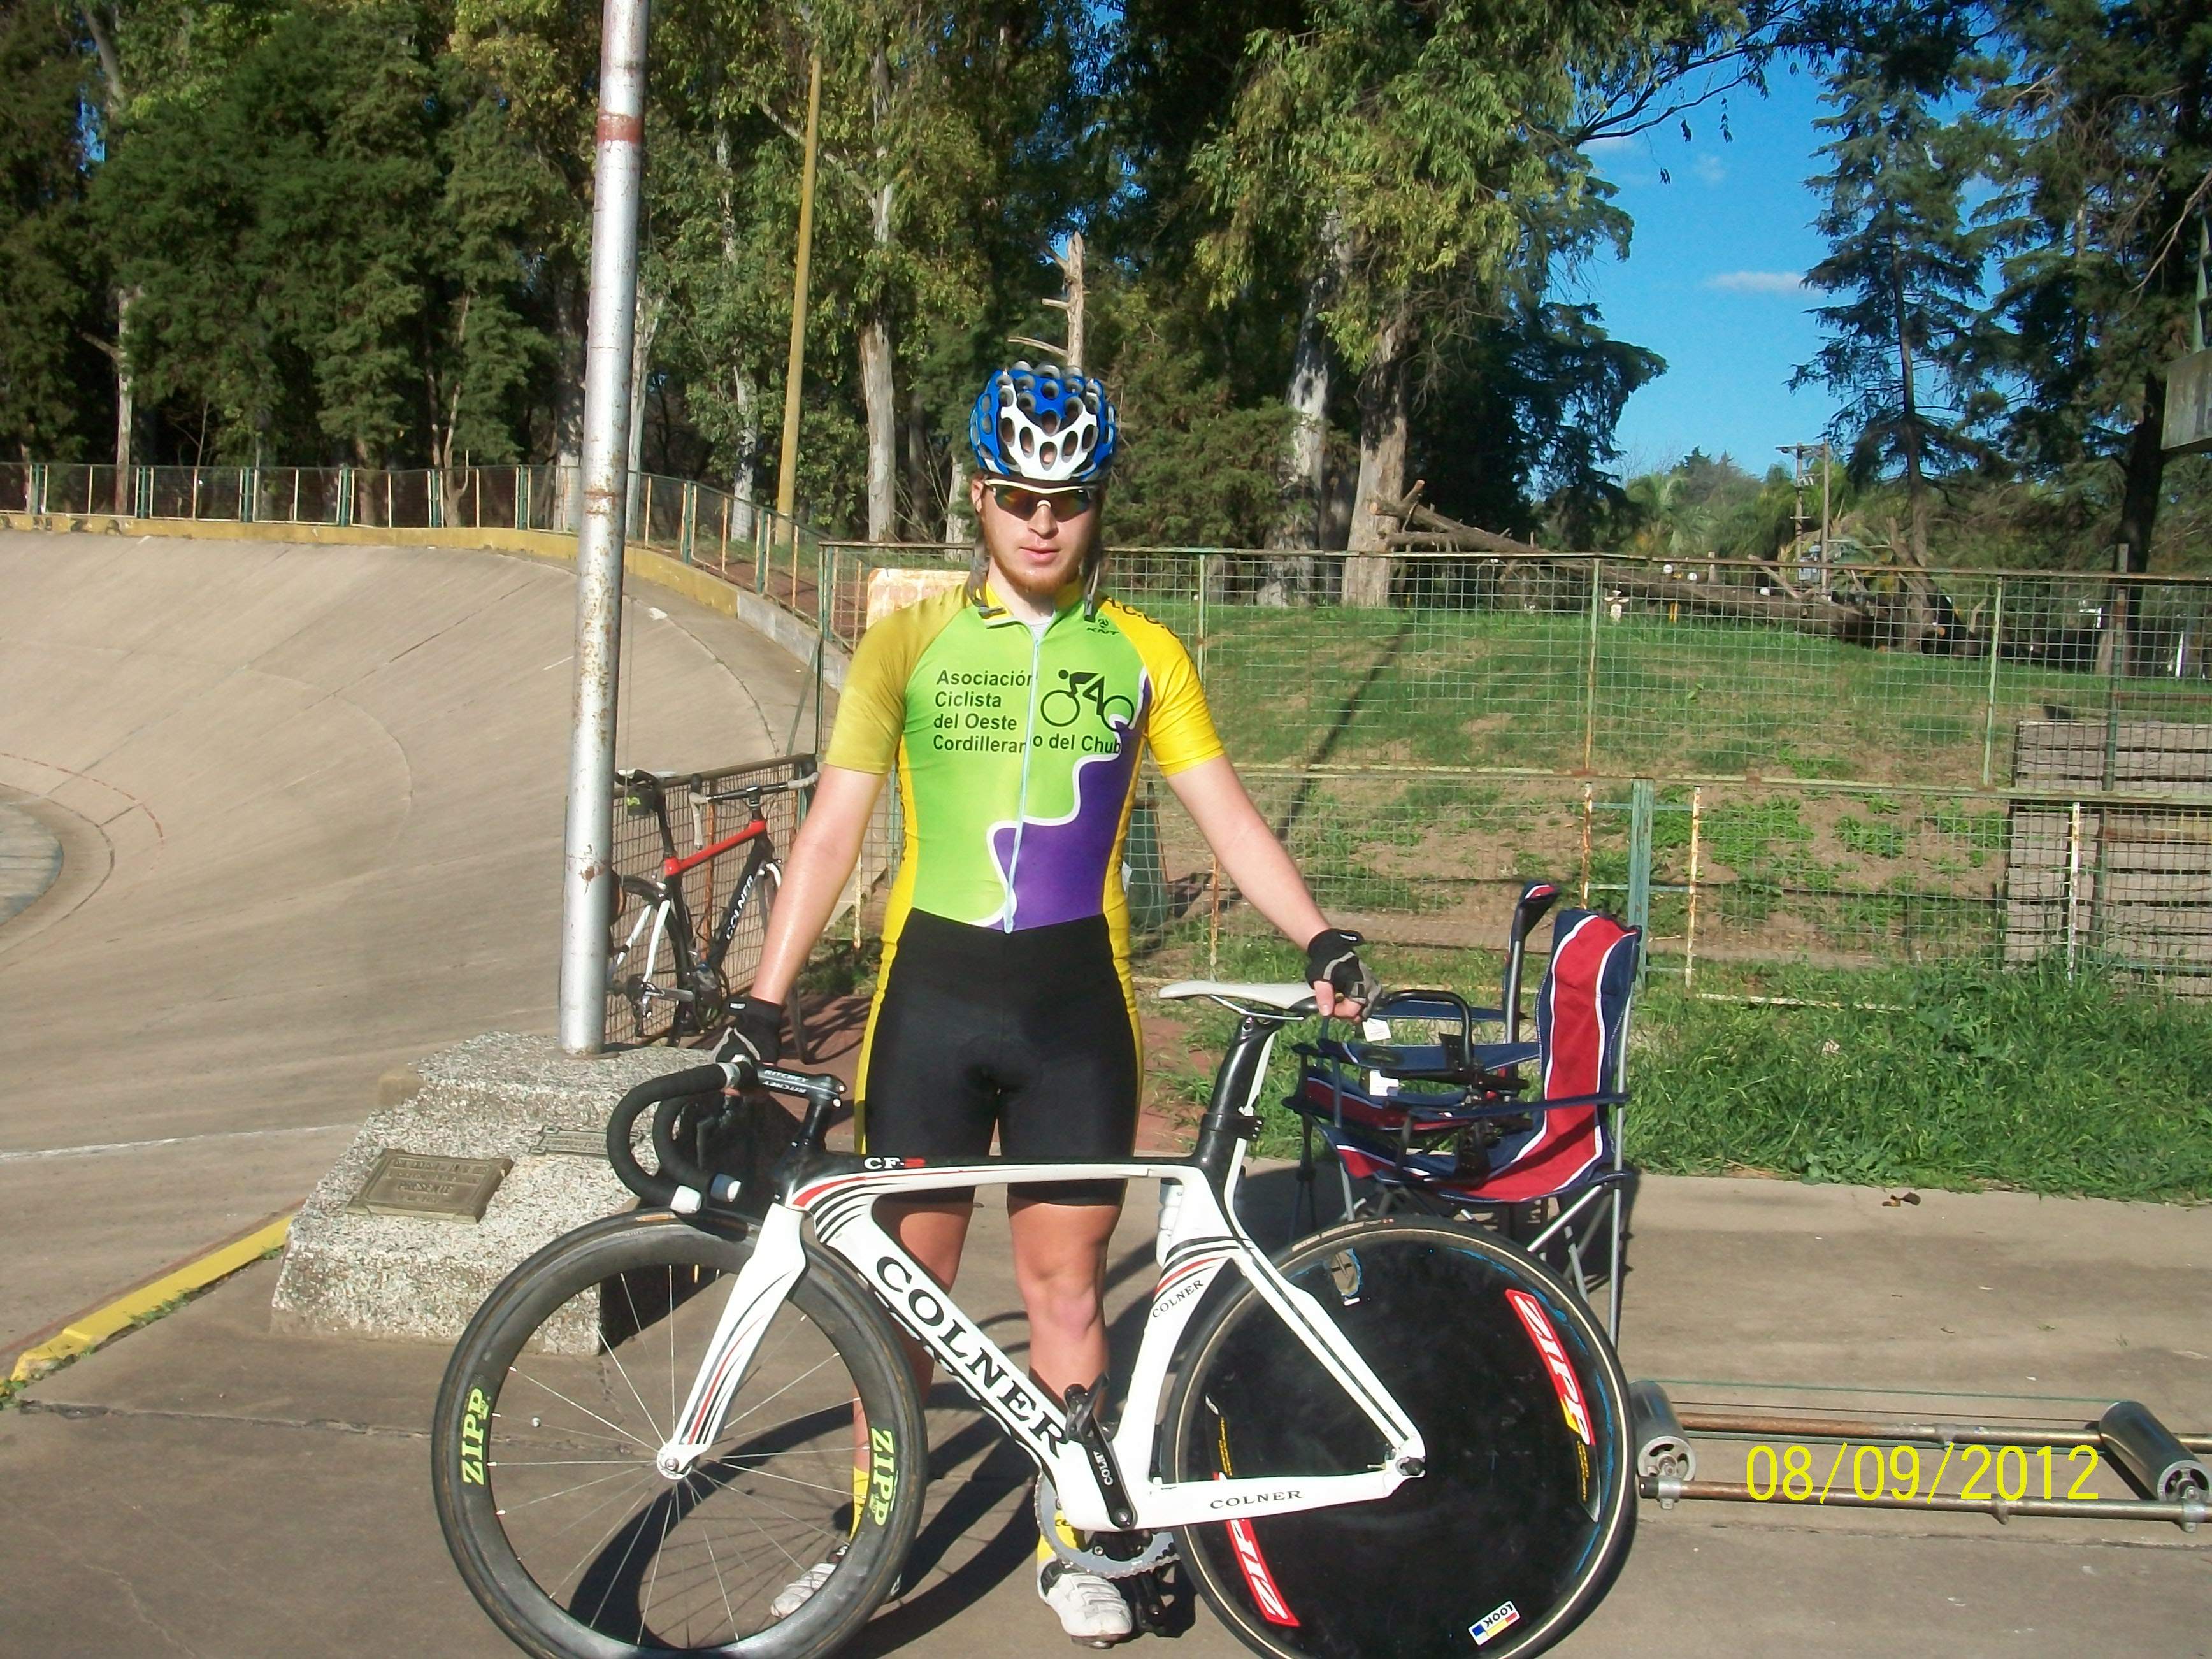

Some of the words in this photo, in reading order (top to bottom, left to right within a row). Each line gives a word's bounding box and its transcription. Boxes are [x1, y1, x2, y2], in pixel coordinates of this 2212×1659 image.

[935, 691, 1002, 707] Ciclista
[933, 713, 958, 729] del
[965, 713, 1017, 731] Oeste
[1049, 733, 1075, 750] del
[726, 875, 754, 940] COLNER
[764, 1069, 810, 1082] RITCHEY
[1153, 1280, 1203, 1318] COLNER
[877, 1256, 1068, 1459] COLNER
[1514, 1295, 1590, 1446] ZIPP
[461, 1388, 489, 1486] ZIPP
[869, 1427, 895, 1526] ZIPP
[1210, 1490, 1303, 1509] COLNER
[1483, 1604, 1514, 1628] LOOK
